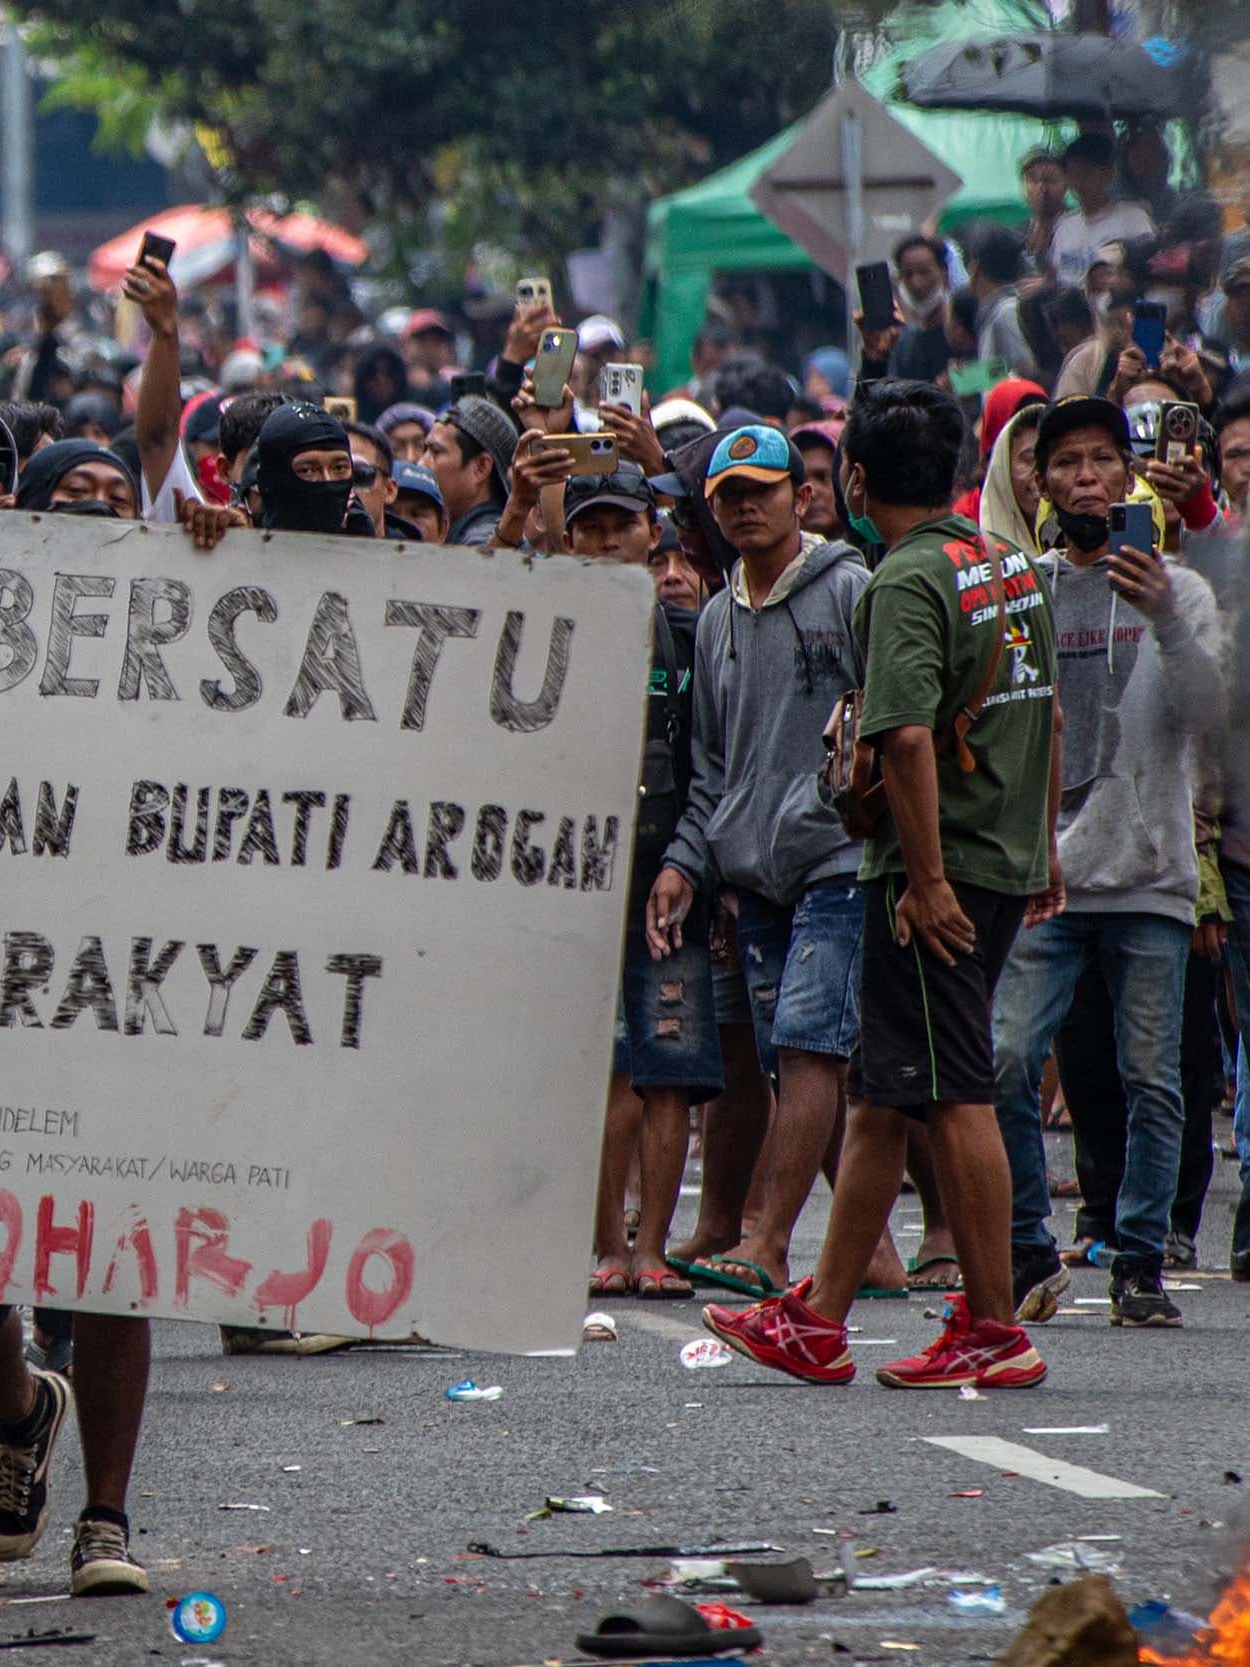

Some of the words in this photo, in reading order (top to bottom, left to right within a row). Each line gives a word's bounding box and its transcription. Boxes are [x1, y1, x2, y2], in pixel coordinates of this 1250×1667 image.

[125, 778, 352, 872] BUPATI
[369, 798, 621, 894] AROGAN
[248, 1164, 292, 1189] PATI
